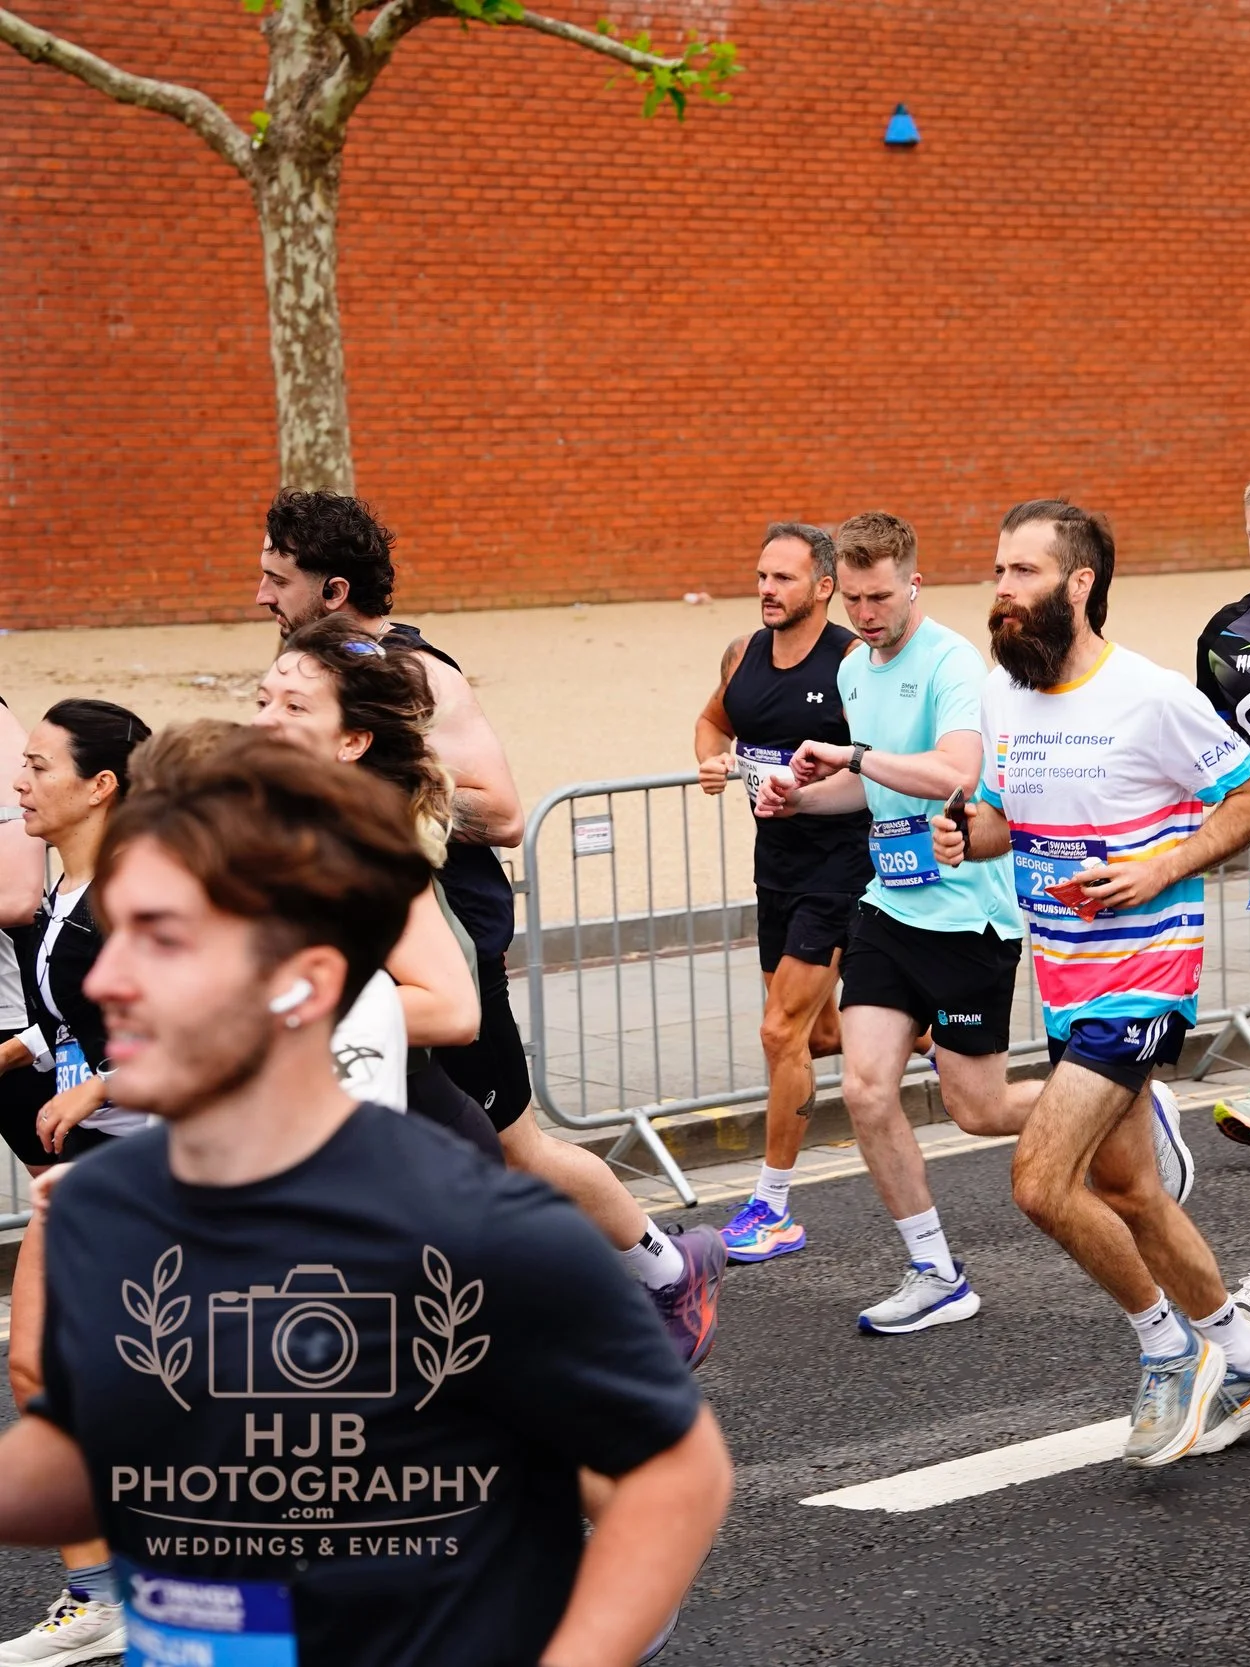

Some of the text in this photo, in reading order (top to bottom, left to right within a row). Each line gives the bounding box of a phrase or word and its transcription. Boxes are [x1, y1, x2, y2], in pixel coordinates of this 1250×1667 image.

[1013, 731, 1115, 747] ymchwil canser
[1010, 750, 1046, 763] cymru
[1008, 765, 1106, 779] cancer research
[747, 772, 764, 790] 49
[1009, 781, 1044, 794] wales
[882, 820, 910, 830] SWANSEA
[1050, 841, 1087, 850] SWANSEA
[879, 850, 919, 873] 6269
[1015, 855, 1055, 873] GEORGE
